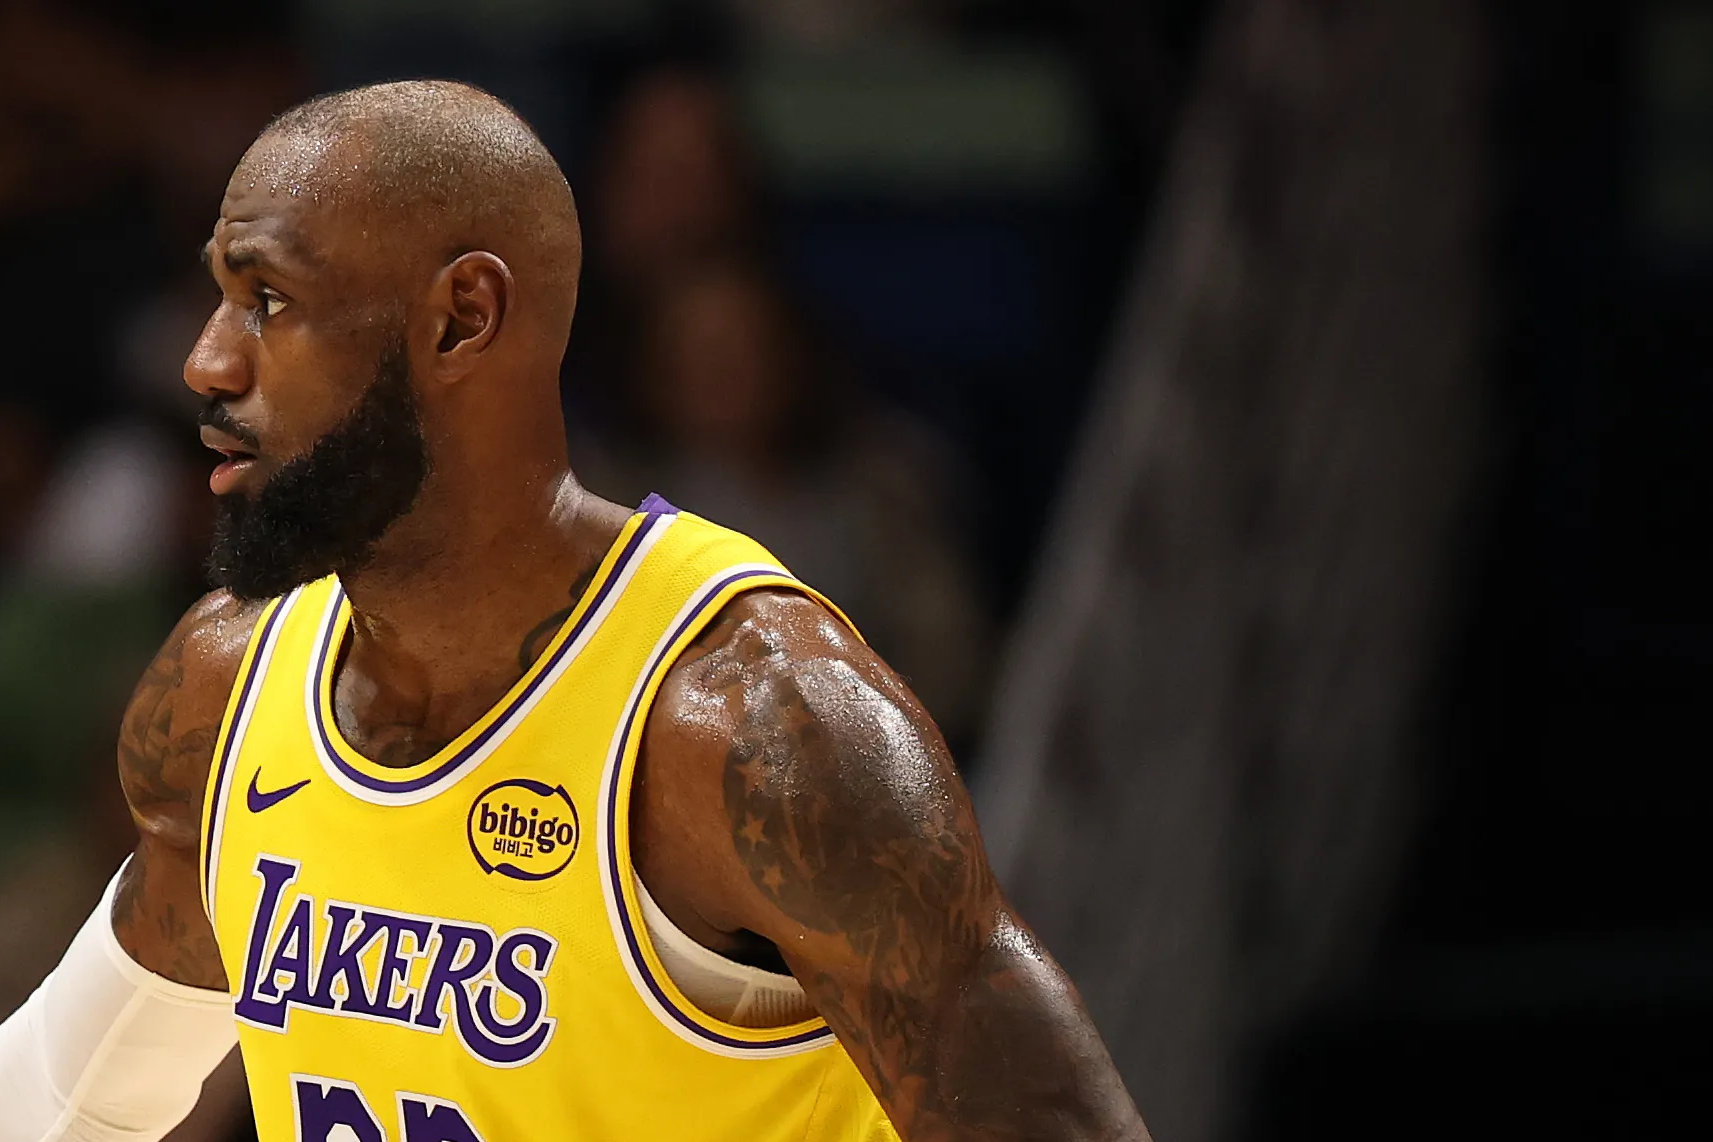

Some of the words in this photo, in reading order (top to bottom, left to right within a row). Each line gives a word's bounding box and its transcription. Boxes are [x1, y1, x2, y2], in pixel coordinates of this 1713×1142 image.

[479, 803, 573, 853] bibigo
[493, 838, 533, 858] 비비고
[233, 852, 559, 1067] LAKERS
